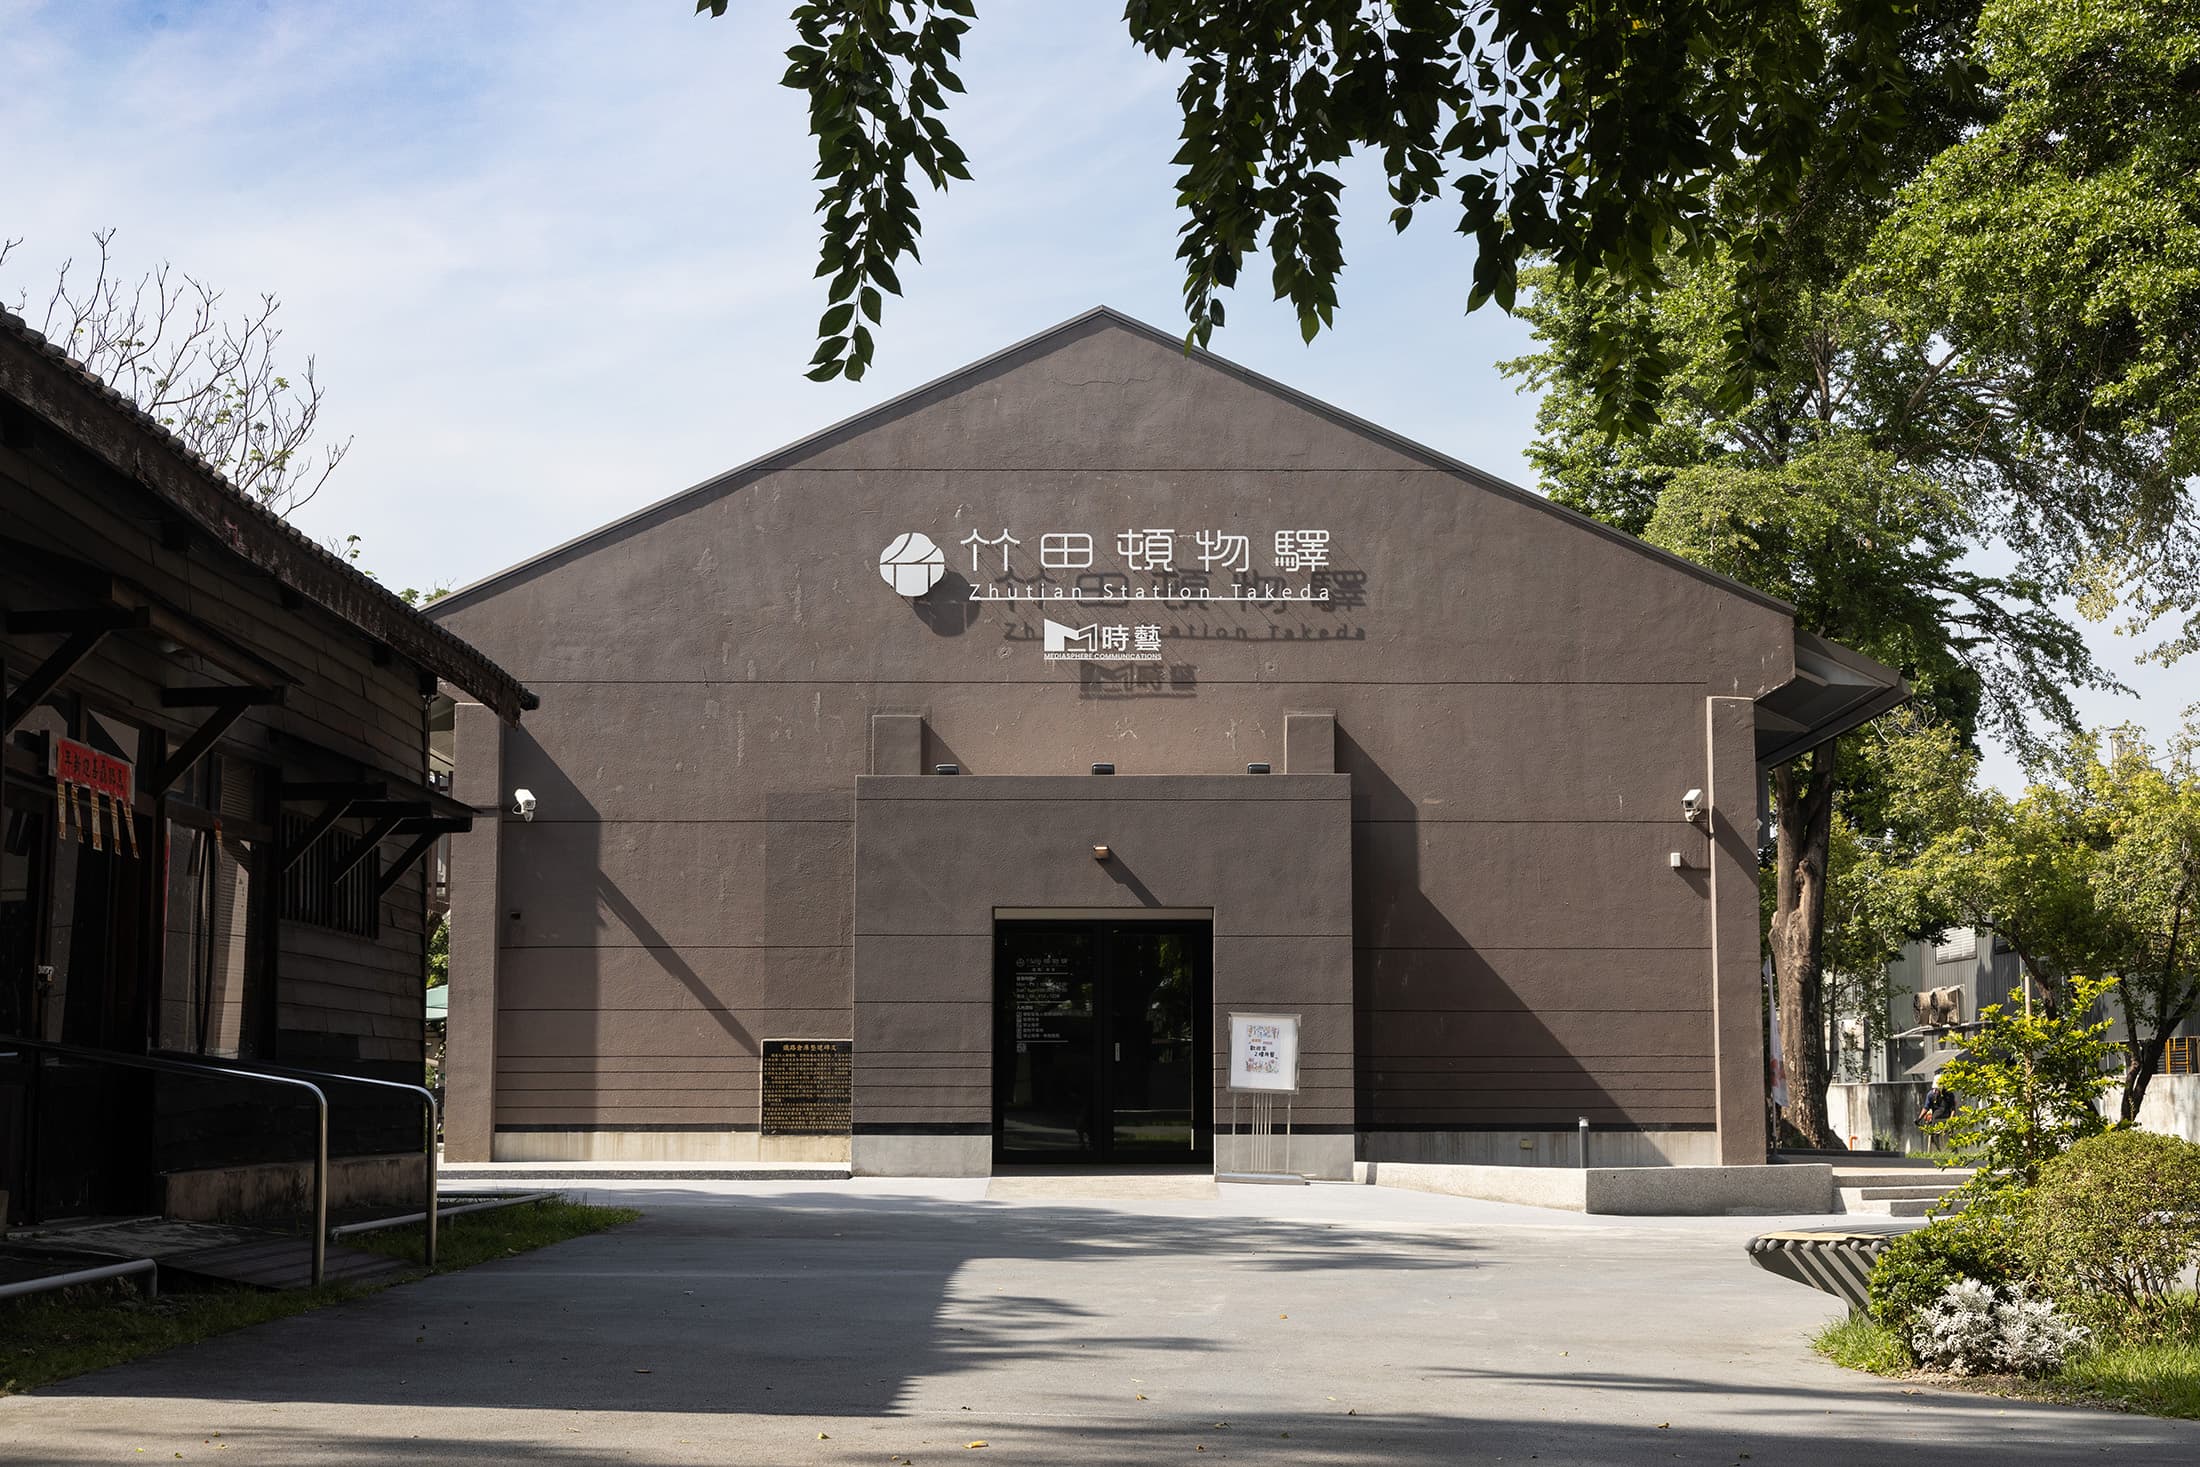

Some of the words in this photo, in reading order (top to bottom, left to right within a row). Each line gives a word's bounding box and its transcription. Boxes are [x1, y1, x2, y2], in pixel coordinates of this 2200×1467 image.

[960, 528, 1329, 572] 竹田頓物驛
[969, 583, 1083, 599] Zhutian
[1102, 624, 1162, 652] 時藝
[1044, 652, 1093, 660] MEDIASPHERE
[1094, 652, 1162, 660] COMMUNICATIONS
